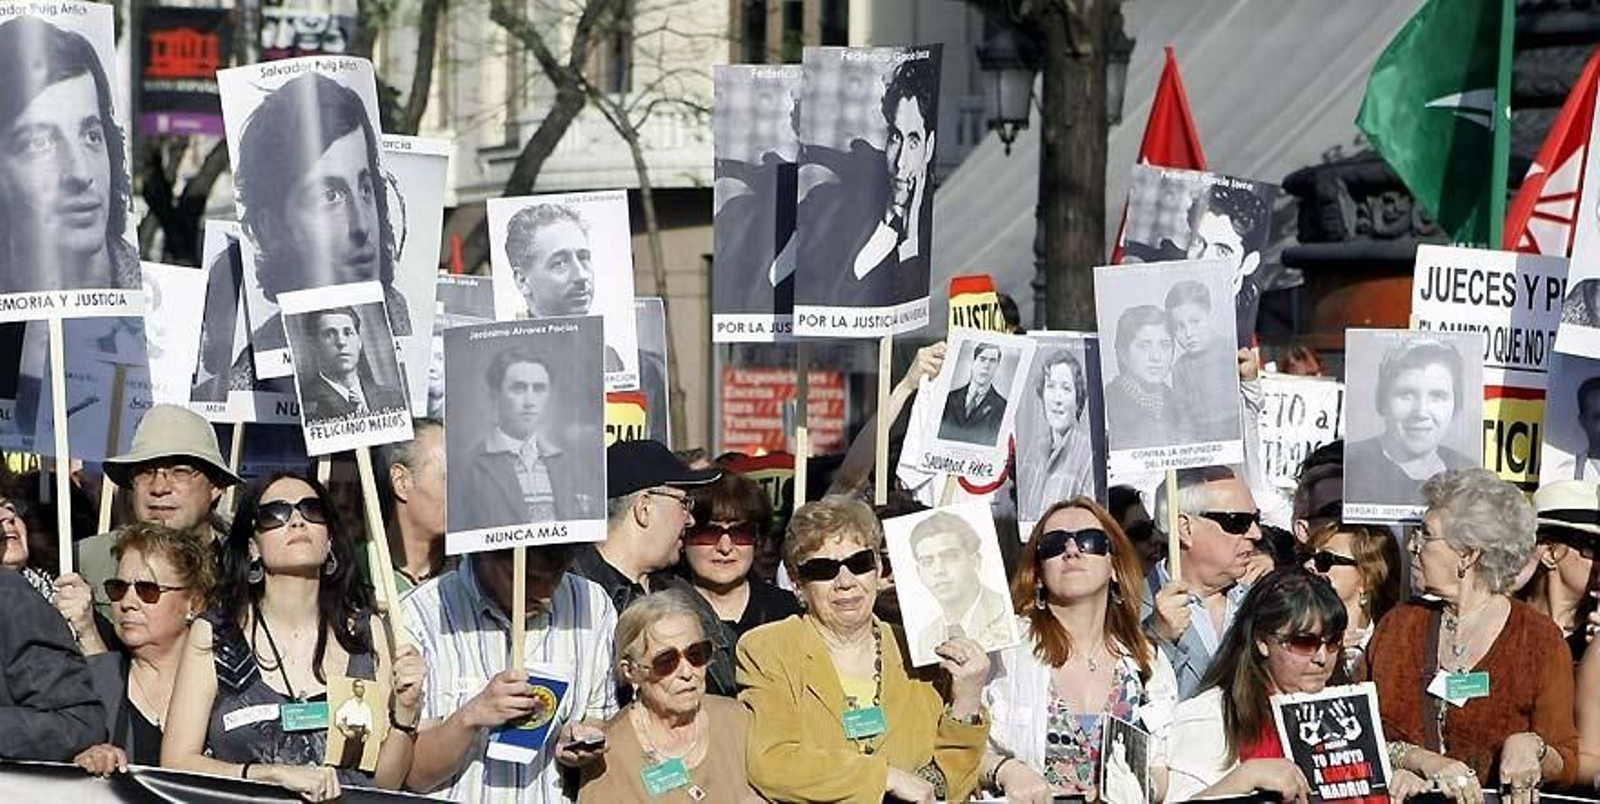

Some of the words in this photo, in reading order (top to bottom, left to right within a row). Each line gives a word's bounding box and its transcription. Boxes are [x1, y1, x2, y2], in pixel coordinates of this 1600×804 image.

[261, 60, 312, 79] Salvador
[1420, 265, 1517, 309] JUECES
[1523, 273, 1540, 310] Y
[59, 294, 68, 307] Y
[74, 291, 128, 307] JUSTICIA
[717, 322, 745, 334] POR
[749, 322, 765, 334] LA
[769, 322, 792, 334] JUS
[799, 313, 826, 328] POR
[831, 314, 848, 328] LA
[852, 312, 898, 329] JUSTICIA
[1493, 326, 1522, 365] QUE
[1524, 330, 1544, 366] NO
[1344, 506, 1379, 516] VERDAD
[485, 528, 535, 544] NUNCA
[537, 522, 568, 539] MÁS
[1312, 753, 1328, 768] YO
[1329, 748, 1364, 767] APOYO
[1319, 779, 1370, 800] MADRID
